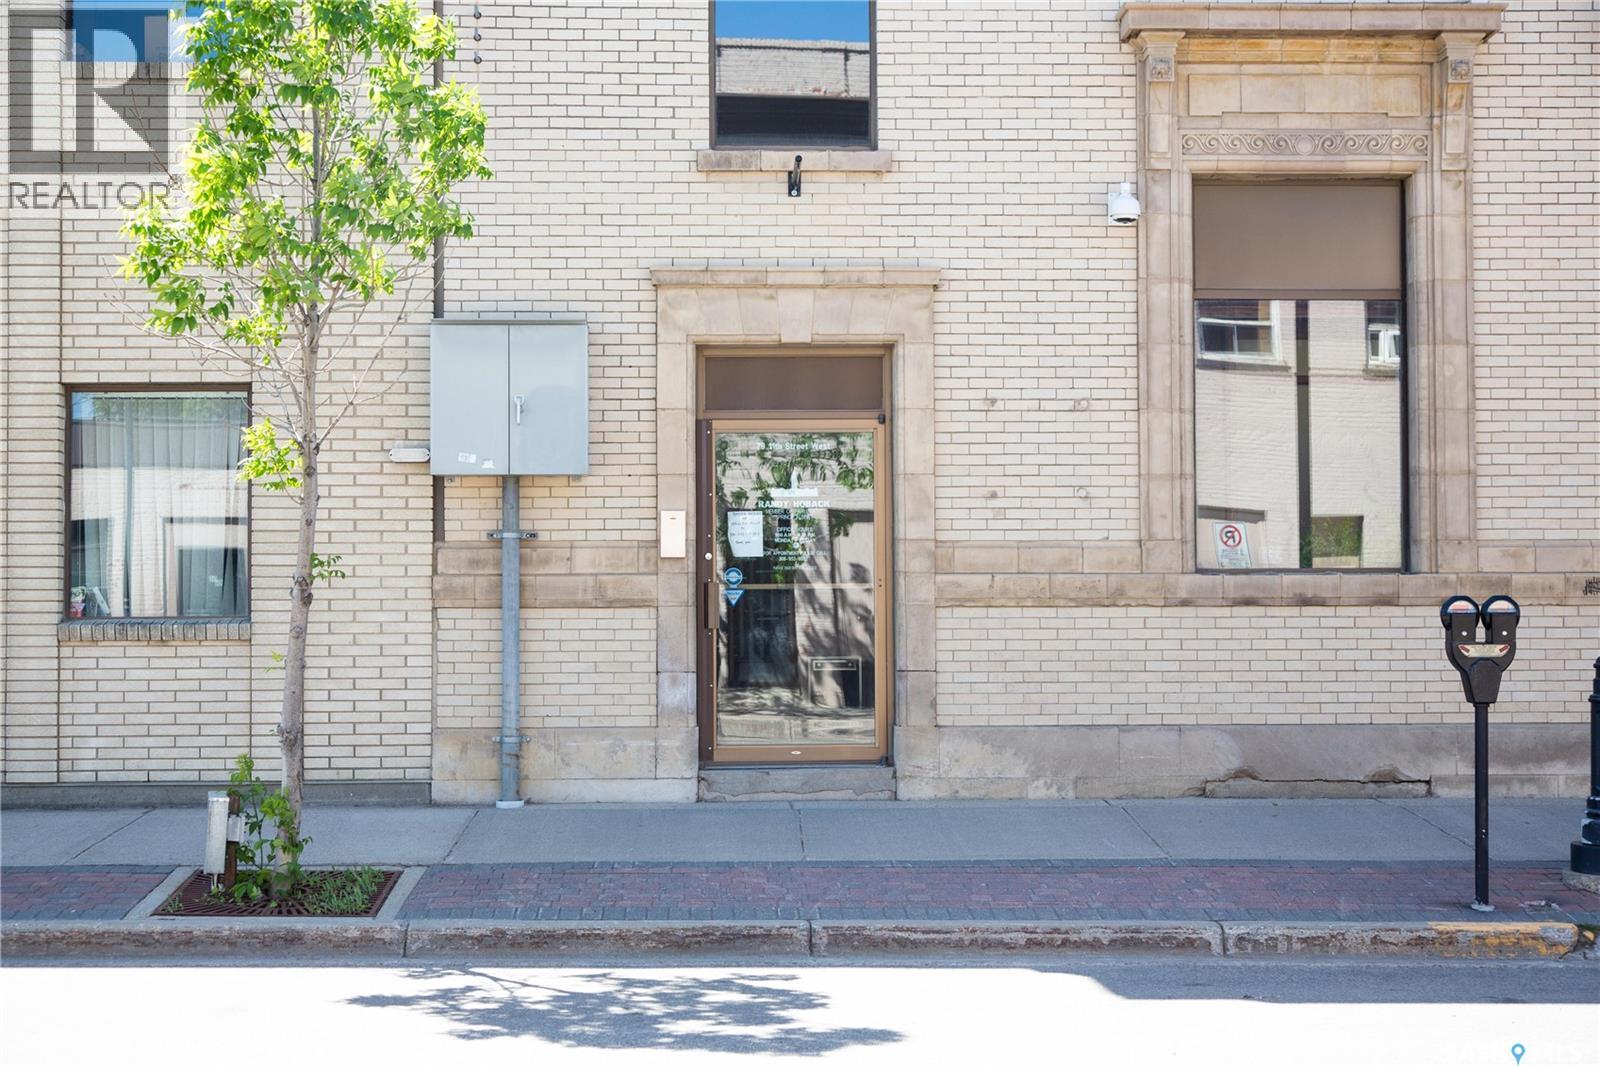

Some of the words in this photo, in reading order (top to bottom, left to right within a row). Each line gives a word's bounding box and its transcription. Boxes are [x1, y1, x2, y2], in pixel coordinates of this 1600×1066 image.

[784, 441, 808, 450] Street
[811, 441, 831, 450] West
[758, 500, 789, 508] RANDY
[793, 500, 831, 508] HOBACK
